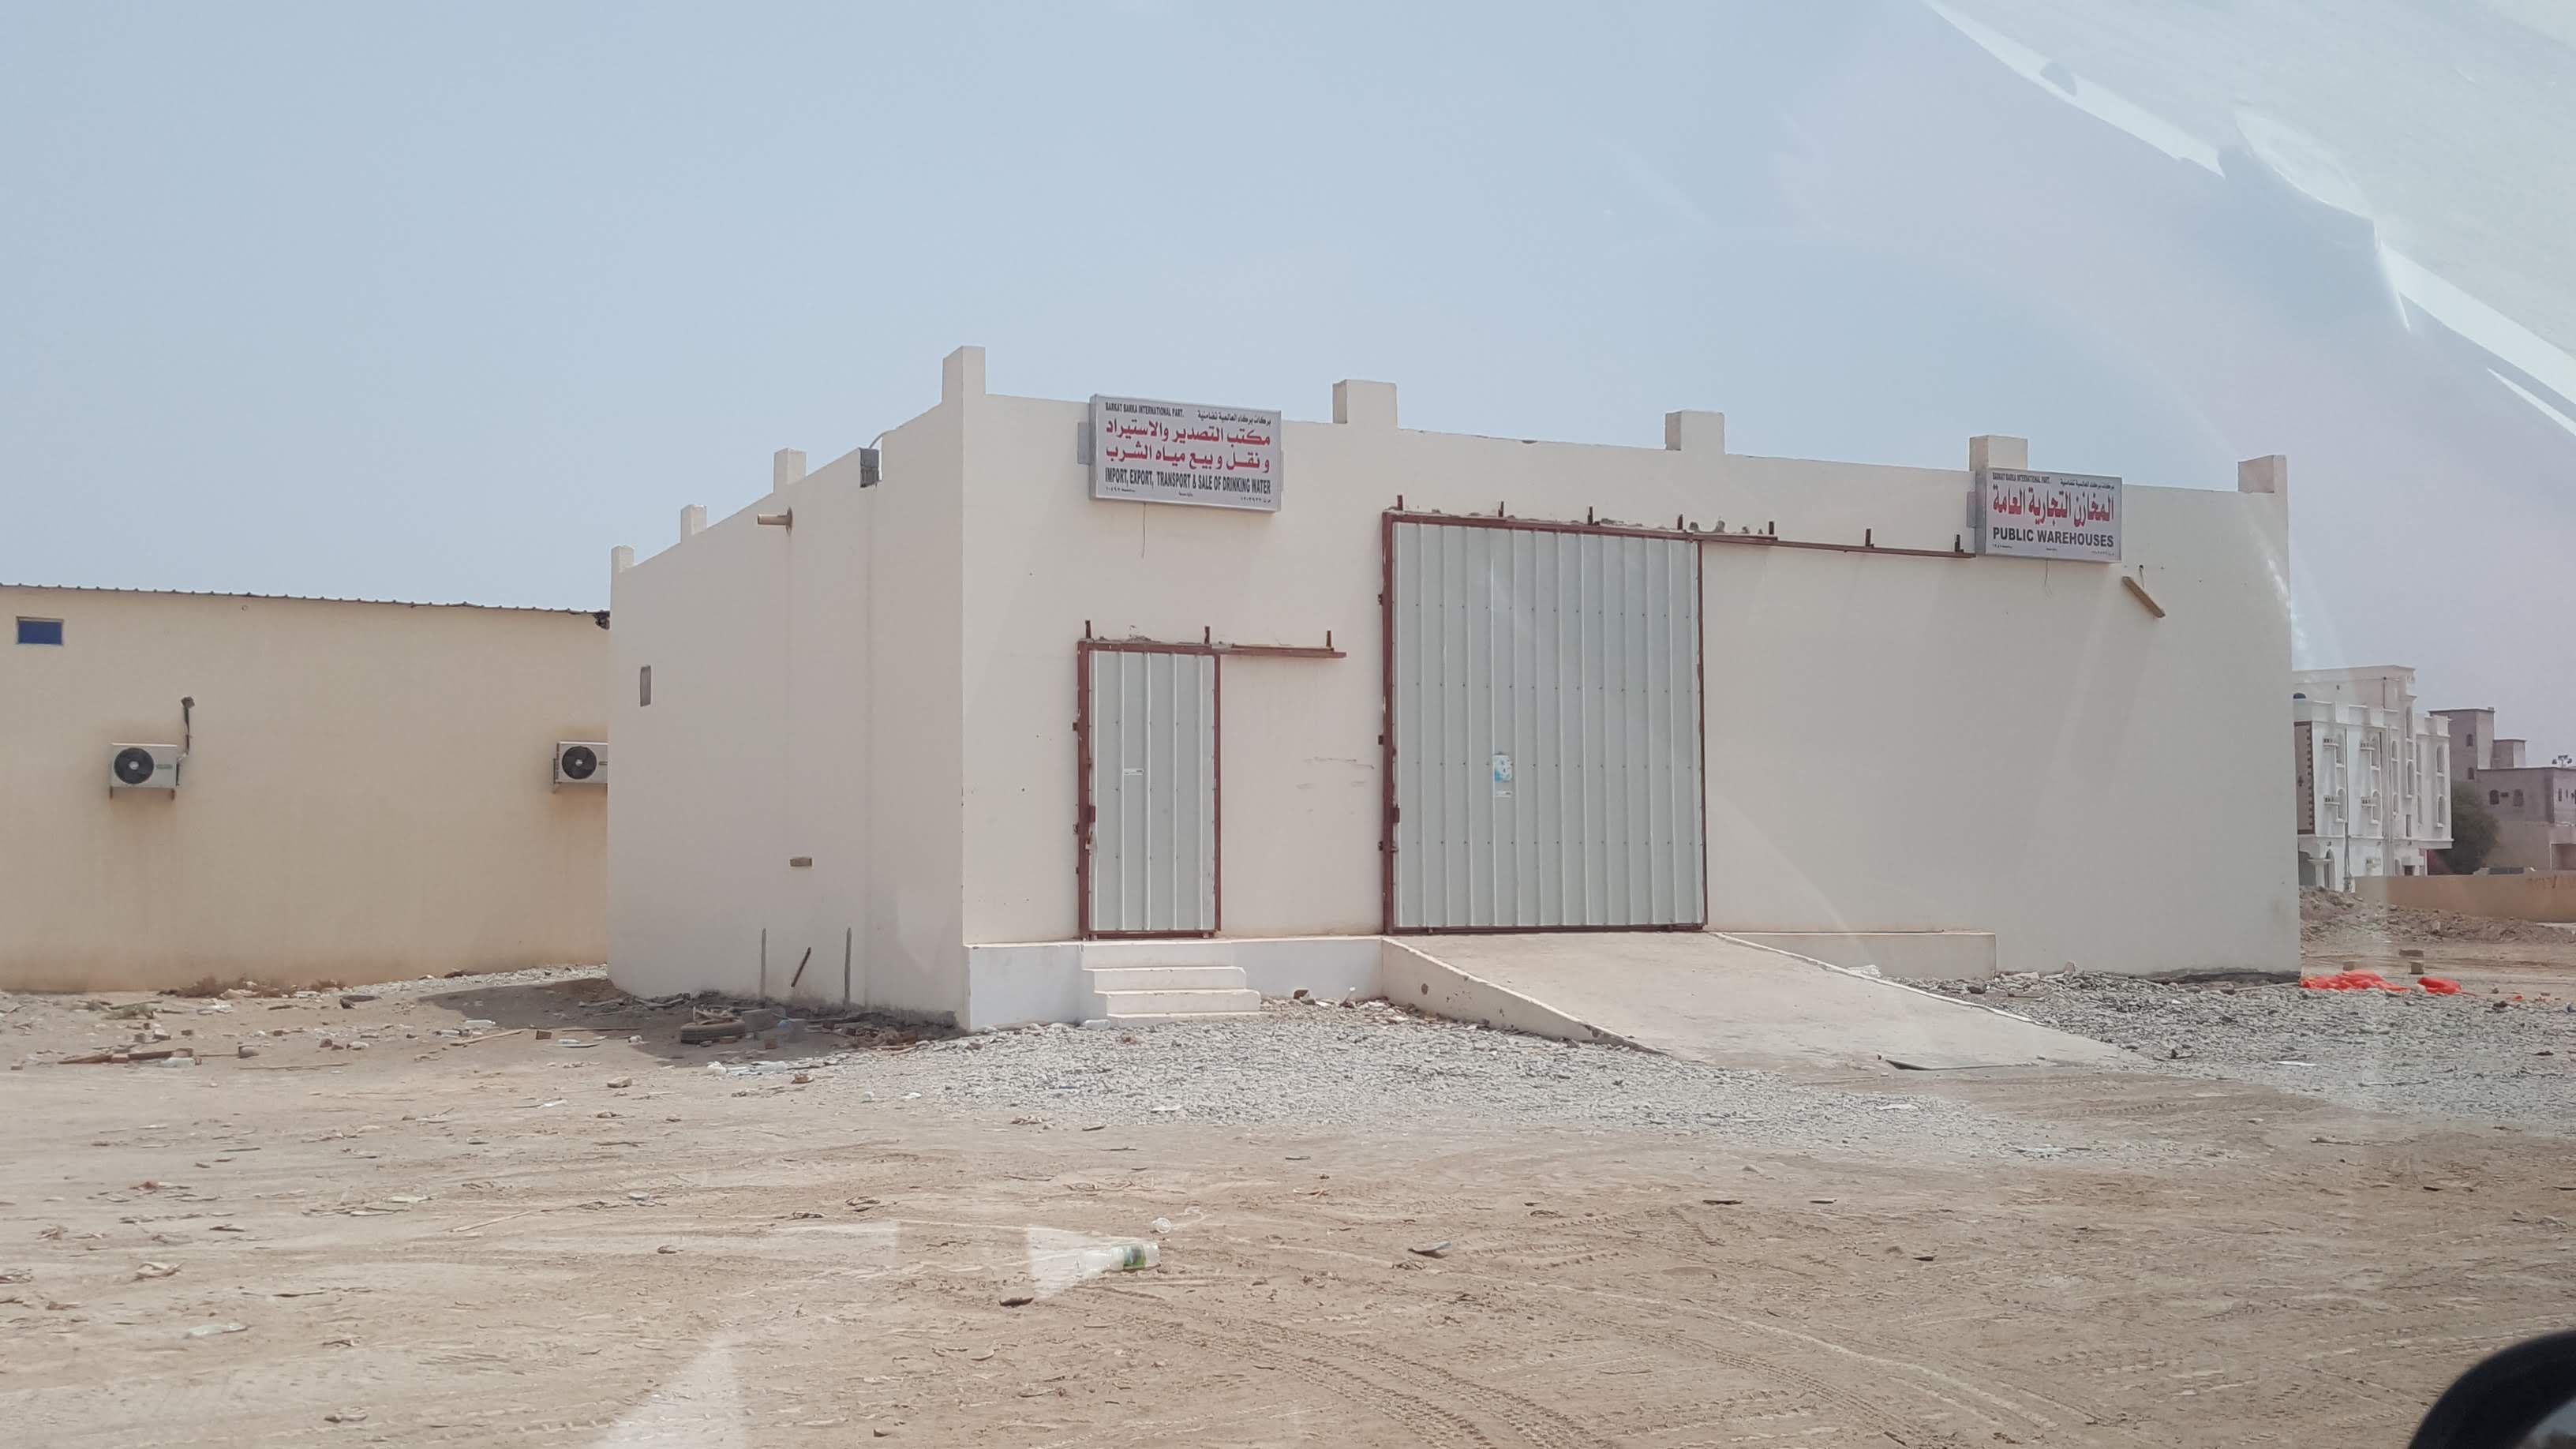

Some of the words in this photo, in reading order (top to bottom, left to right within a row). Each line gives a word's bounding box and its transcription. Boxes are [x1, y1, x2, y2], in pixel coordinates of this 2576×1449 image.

[1123, 403, 1137, 414] BARKA
[1138, 405, 1171, 417] INTERNATIONAL
[1106, 418, 1169, 442] والاستيراد
[1171, 425, 1223, 444] التصدير
[1226, 428, 1271, 447] مكتب
[1106, 440, 1152, 462] الشرب
[1155, 445, 1185, 466] مياه
[1105, 467, 1129, 487] IMPORT,
[1129, 469, 1154, 489] EXPORT,
[1156, 471, 1191, 489] TRANSPORT
[1192, 474, 1197, 489] &
[1198, 474, 1212, 491] SALE
[1213, 475, 1221, 491] OF
[1222, 476, 1251, 493] DRINKING
[1251, 478, 1271, 494] WATER
[1993, 484, 2026, 515] العامة
[2028, 486, 2072, 526] التجارية
[2073, 491, 2114, 527] المخازن
[1993, 526, 2034, 542] PUBLIC
[2037, 530, 2114, 547] WAREHOUSES
